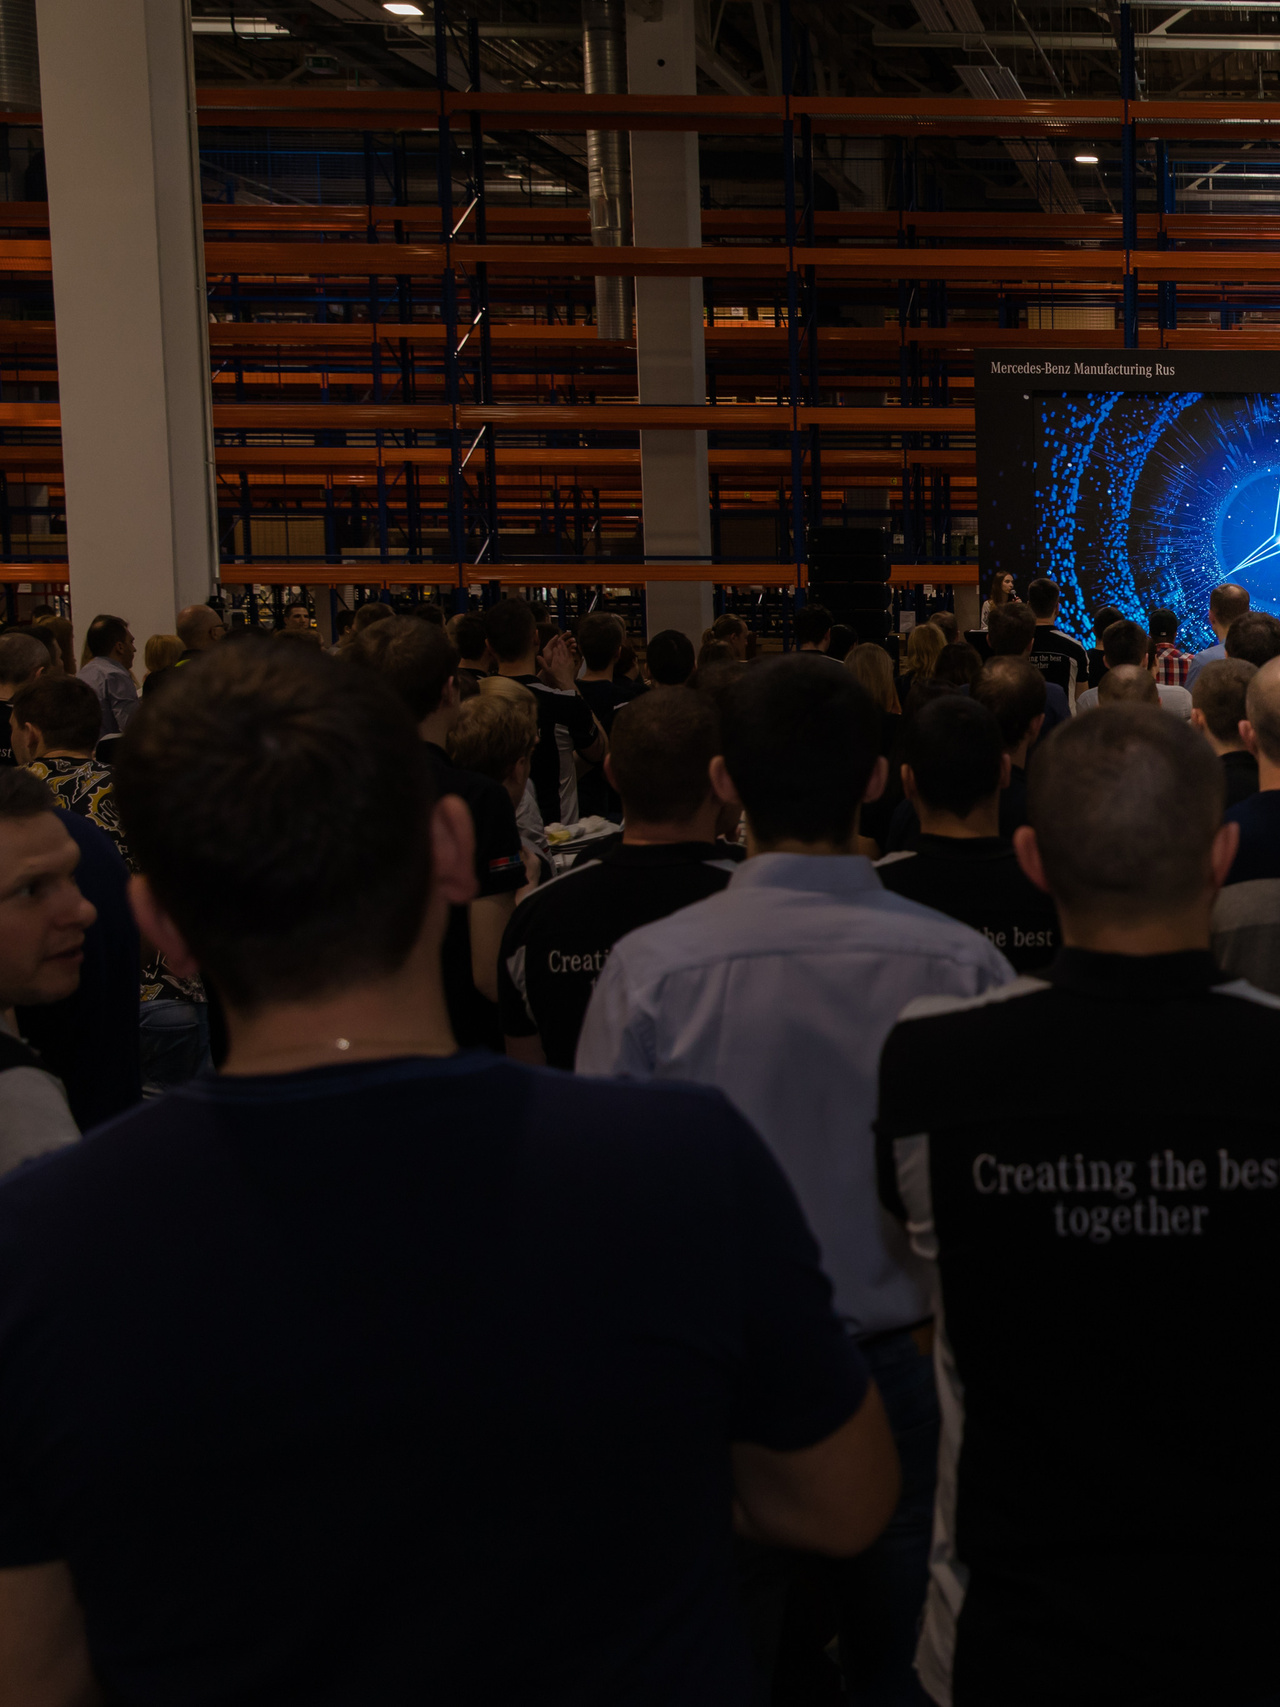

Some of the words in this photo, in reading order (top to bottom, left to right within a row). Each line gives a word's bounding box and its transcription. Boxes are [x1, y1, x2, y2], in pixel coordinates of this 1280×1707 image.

[990, 361, 1071, 375] Mercedes-Benz
[1073, 362, 1153, 379] Manufacturing
[1155, 363, 1176, 376] Rus
[1012, 925, 1054, 948] best
[972, 1151, 1138, 1200] Creating
[1149, 1148, 1208, 1193] the
[1053, 1195, 1210, 1245] together
